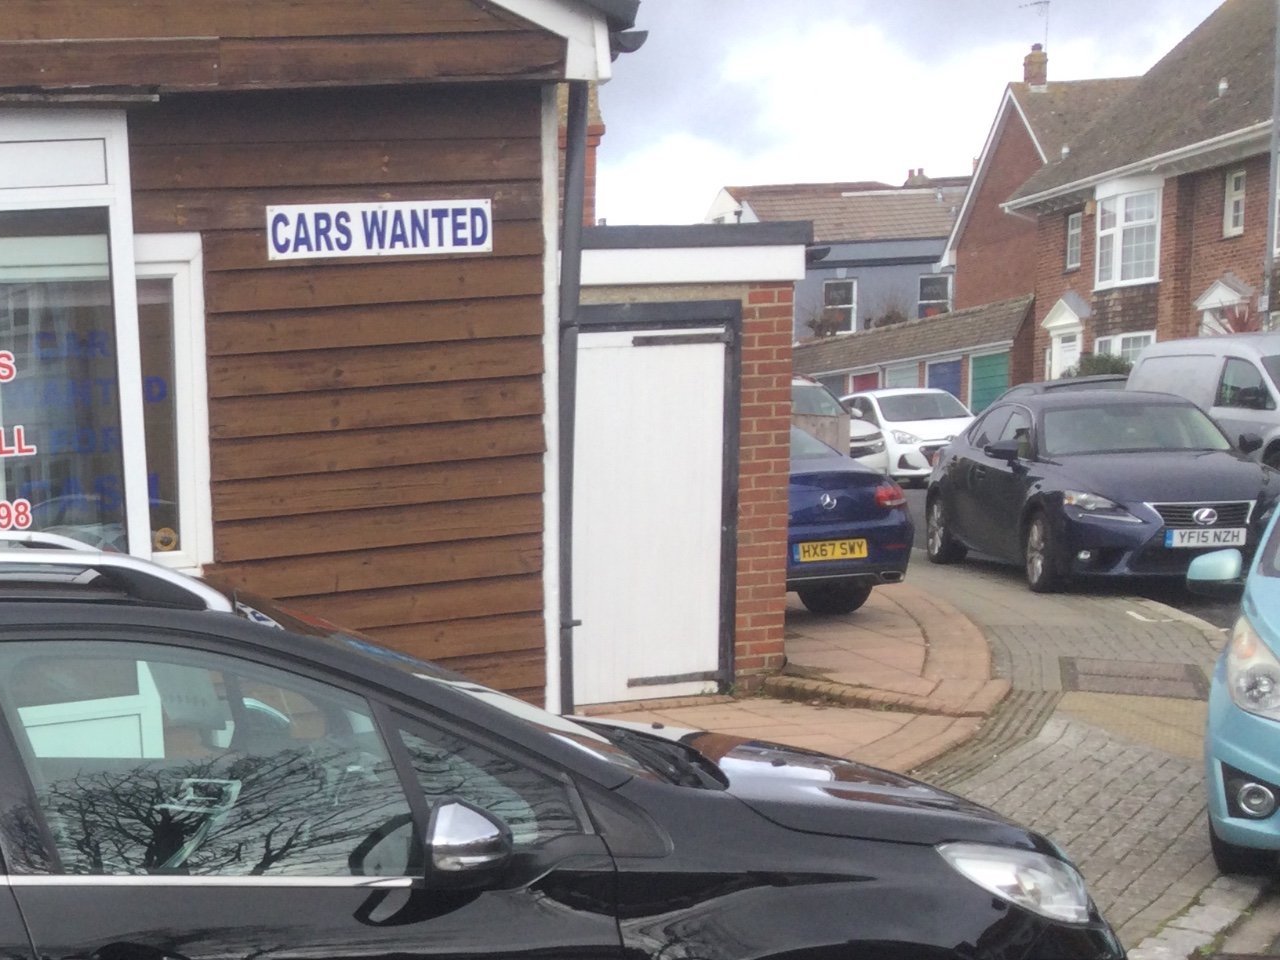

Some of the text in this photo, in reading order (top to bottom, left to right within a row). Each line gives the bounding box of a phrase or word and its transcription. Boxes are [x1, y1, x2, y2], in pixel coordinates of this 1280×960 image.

[271, 207, 489, 254] CARS WANTED
[1179, 530, 1240, 543] YF15 NZH
[801, 541, 864, 558] HX67 SWY
